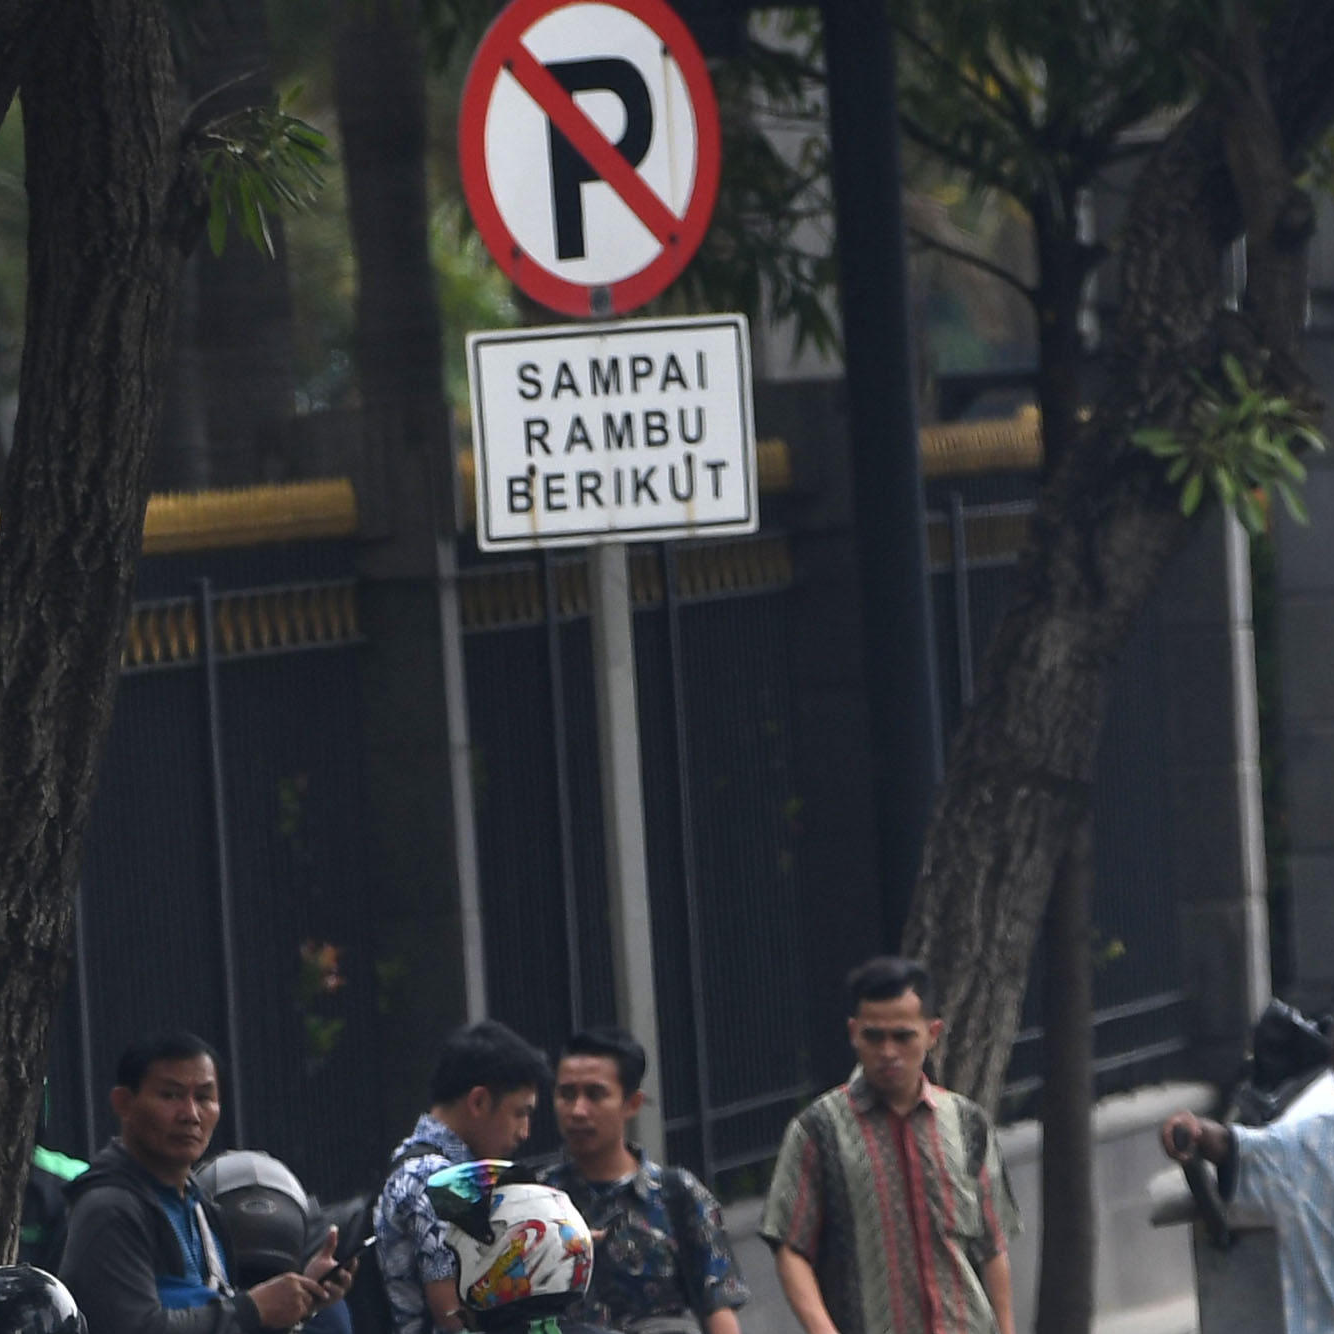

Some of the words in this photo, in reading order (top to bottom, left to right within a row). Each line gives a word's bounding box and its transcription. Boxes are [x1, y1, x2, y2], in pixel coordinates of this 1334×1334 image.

[517, 350, 708, 401] SAMPAI
[524, 406, 706, 456] RAMBU
[506, 459, 730, 514] BERIKUT
